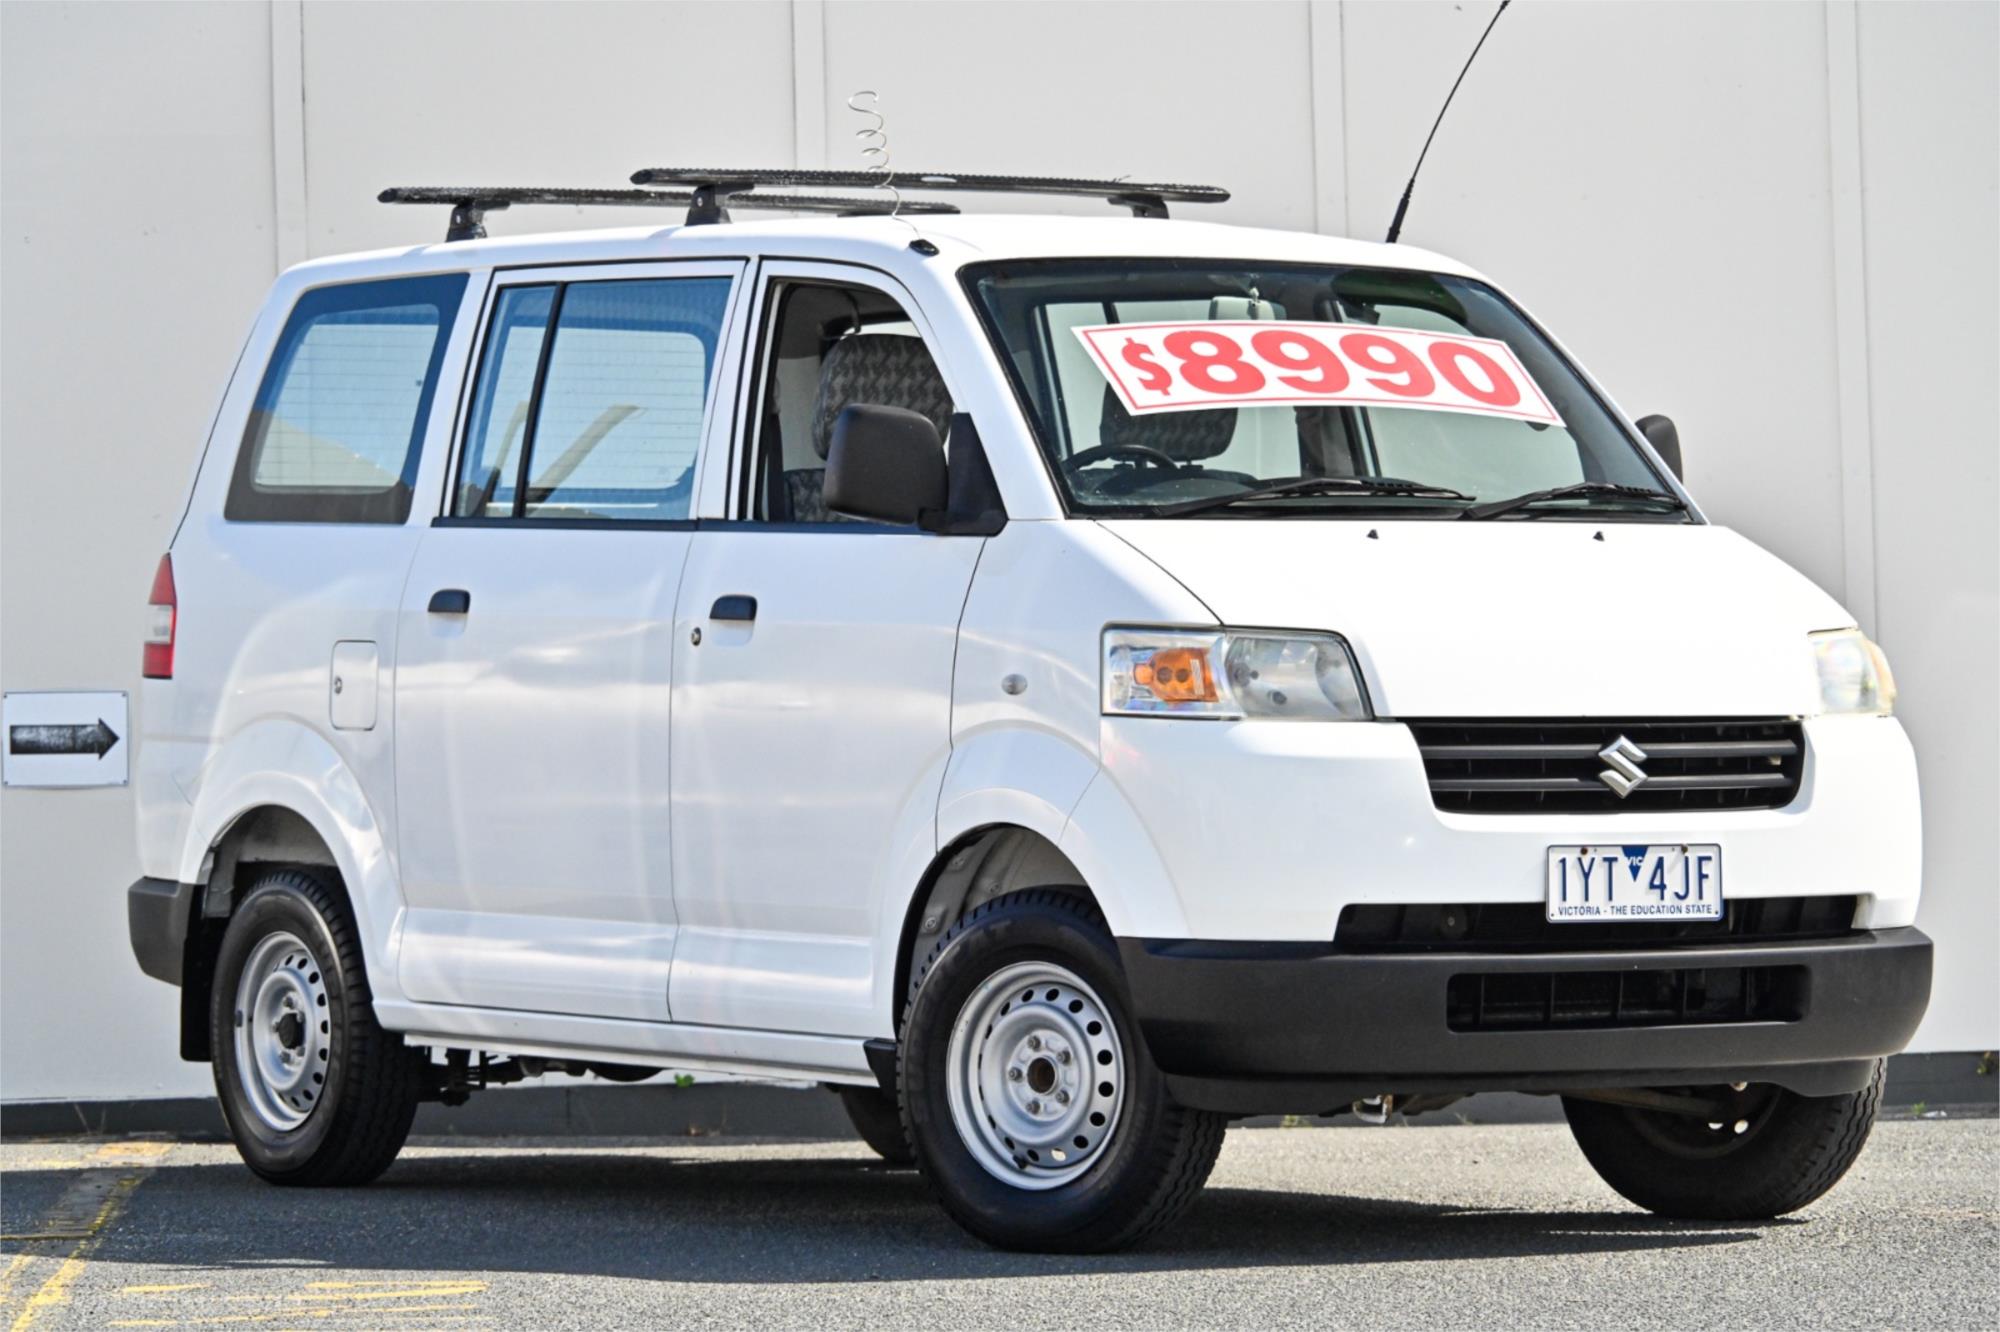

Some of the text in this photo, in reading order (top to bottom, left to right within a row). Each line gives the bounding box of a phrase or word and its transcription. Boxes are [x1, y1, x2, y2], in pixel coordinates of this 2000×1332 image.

[1121, 330, 1521, 407] $8990
[1558, 855, 1713, 902] 1YT 4JF
[1558, 905, 1600, 916] VICTORIA
[1610, 905, 1628, 916] THE
[1630, 904, 1682, 915] EDUCATION
[1685, 904, 1712, 914] STATE
